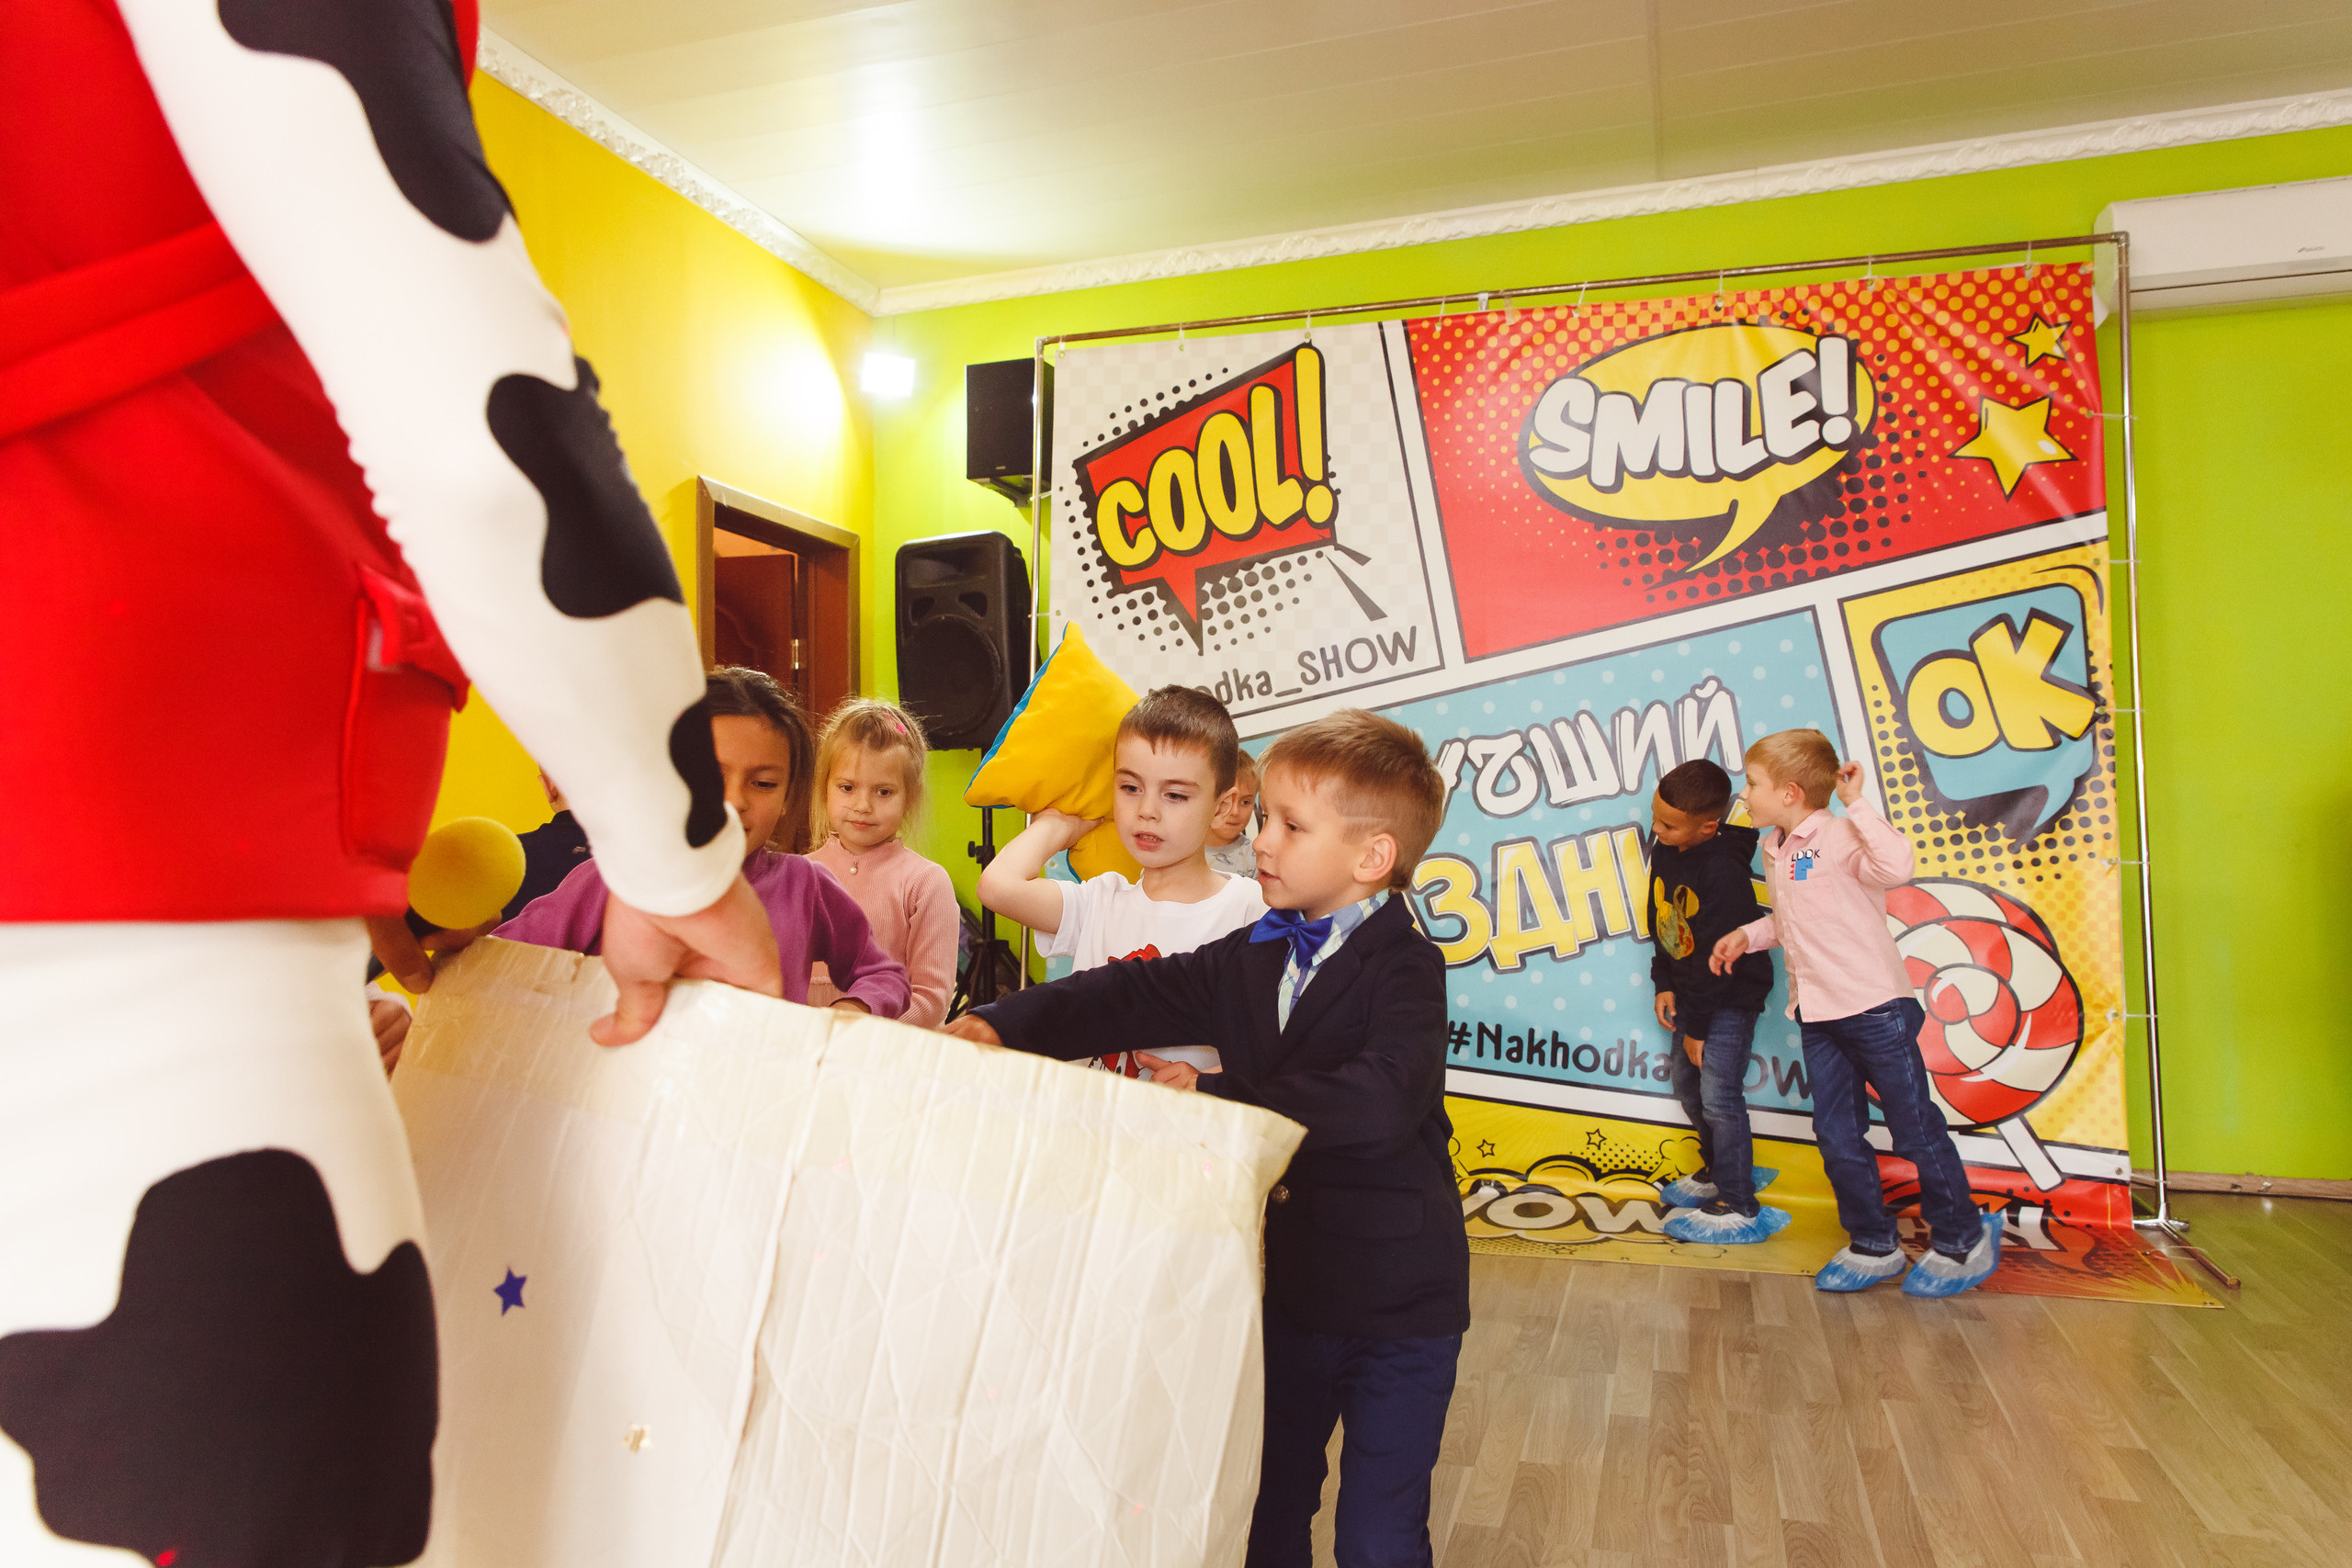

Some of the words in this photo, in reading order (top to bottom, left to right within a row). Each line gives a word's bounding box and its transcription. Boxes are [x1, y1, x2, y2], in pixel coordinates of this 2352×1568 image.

[1094, 344, 1336, 570] COOL!
[1527, 334, 1854, 489] SMILE!
[1905, 611, 2098, 758] OK
[1791, 849, 1821, 863] LOOK
